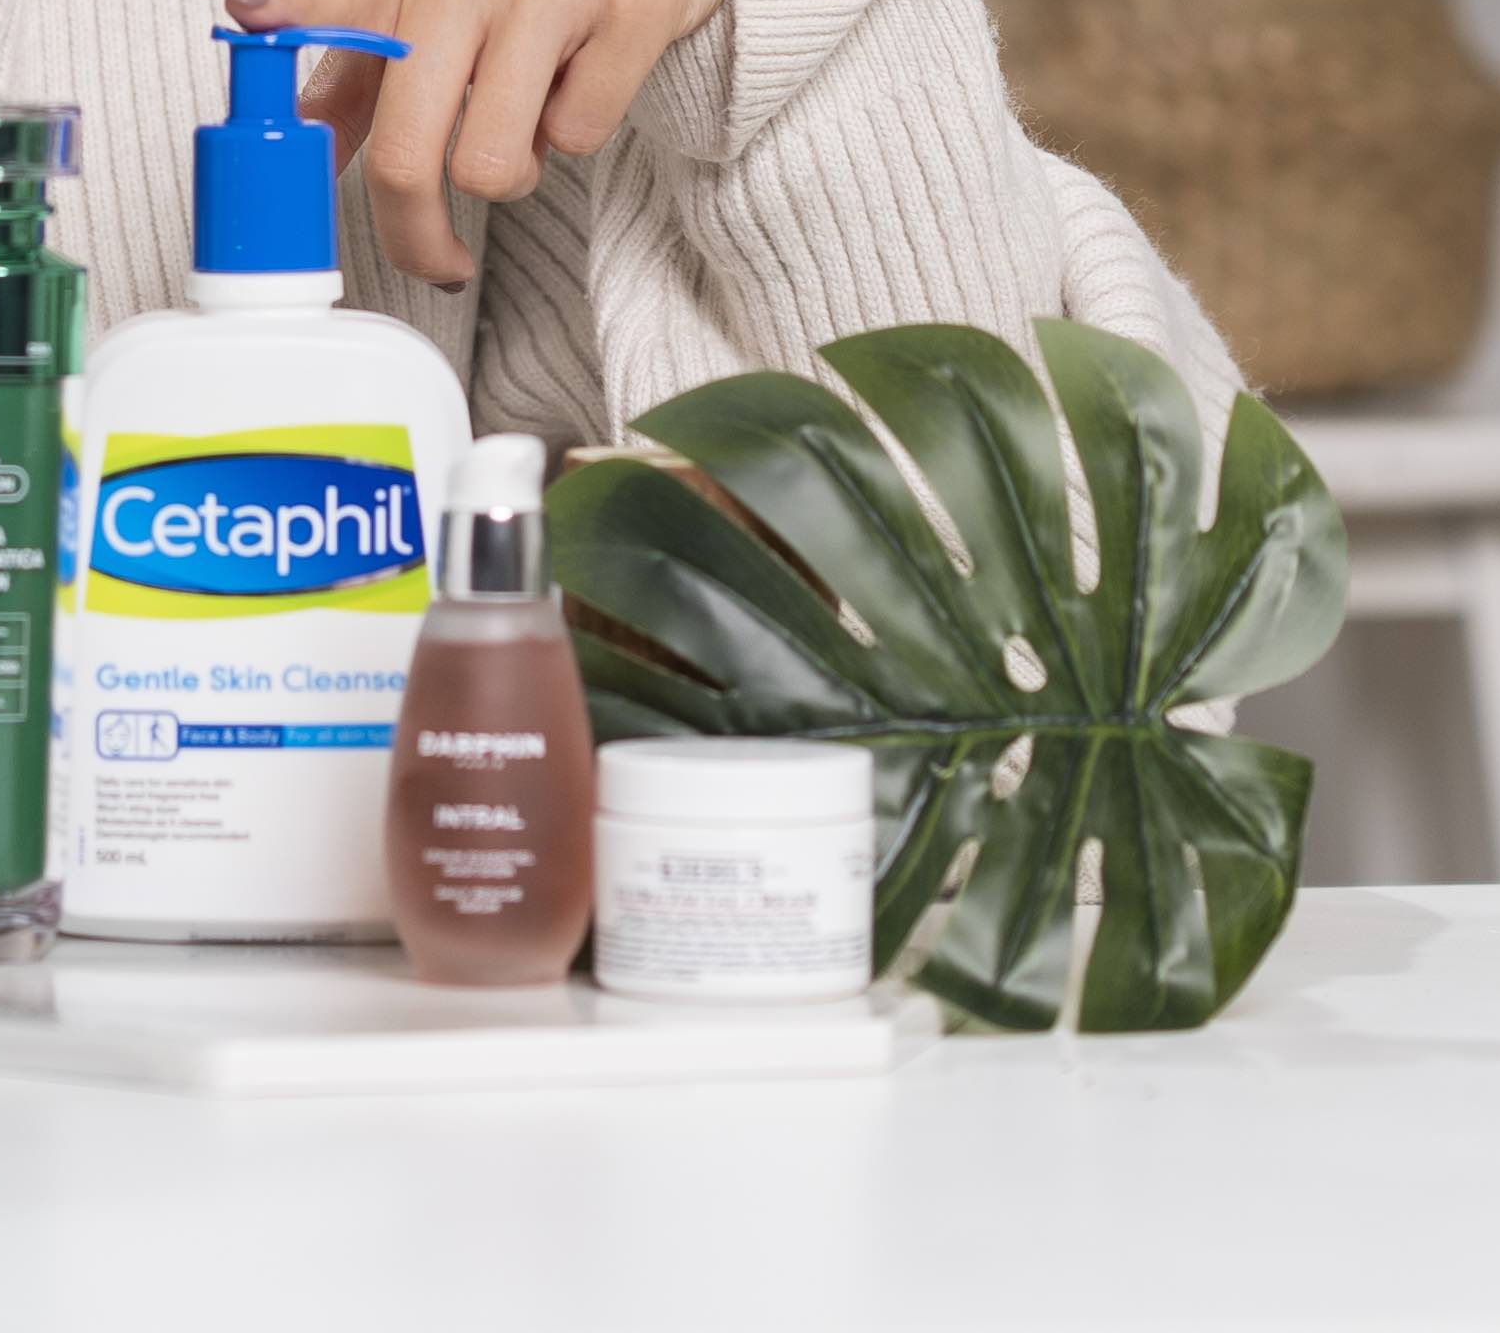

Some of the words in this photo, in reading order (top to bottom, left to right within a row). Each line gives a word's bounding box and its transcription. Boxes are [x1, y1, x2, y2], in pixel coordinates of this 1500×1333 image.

[101, 484, 414, 577] Cetaphil
[96, 663, 199, 692] Gentle
[209, 664, 273, 692] Skin
[282, 663, 409, 692] Cleanse
[181, 726, 219, 745] Face
[237, 726, 281, 748] Body
[417, 731, 547, 759] DARPHIN
[432, 804, 527, 831] INTRAL
[96, 847, 121, 865] 500
